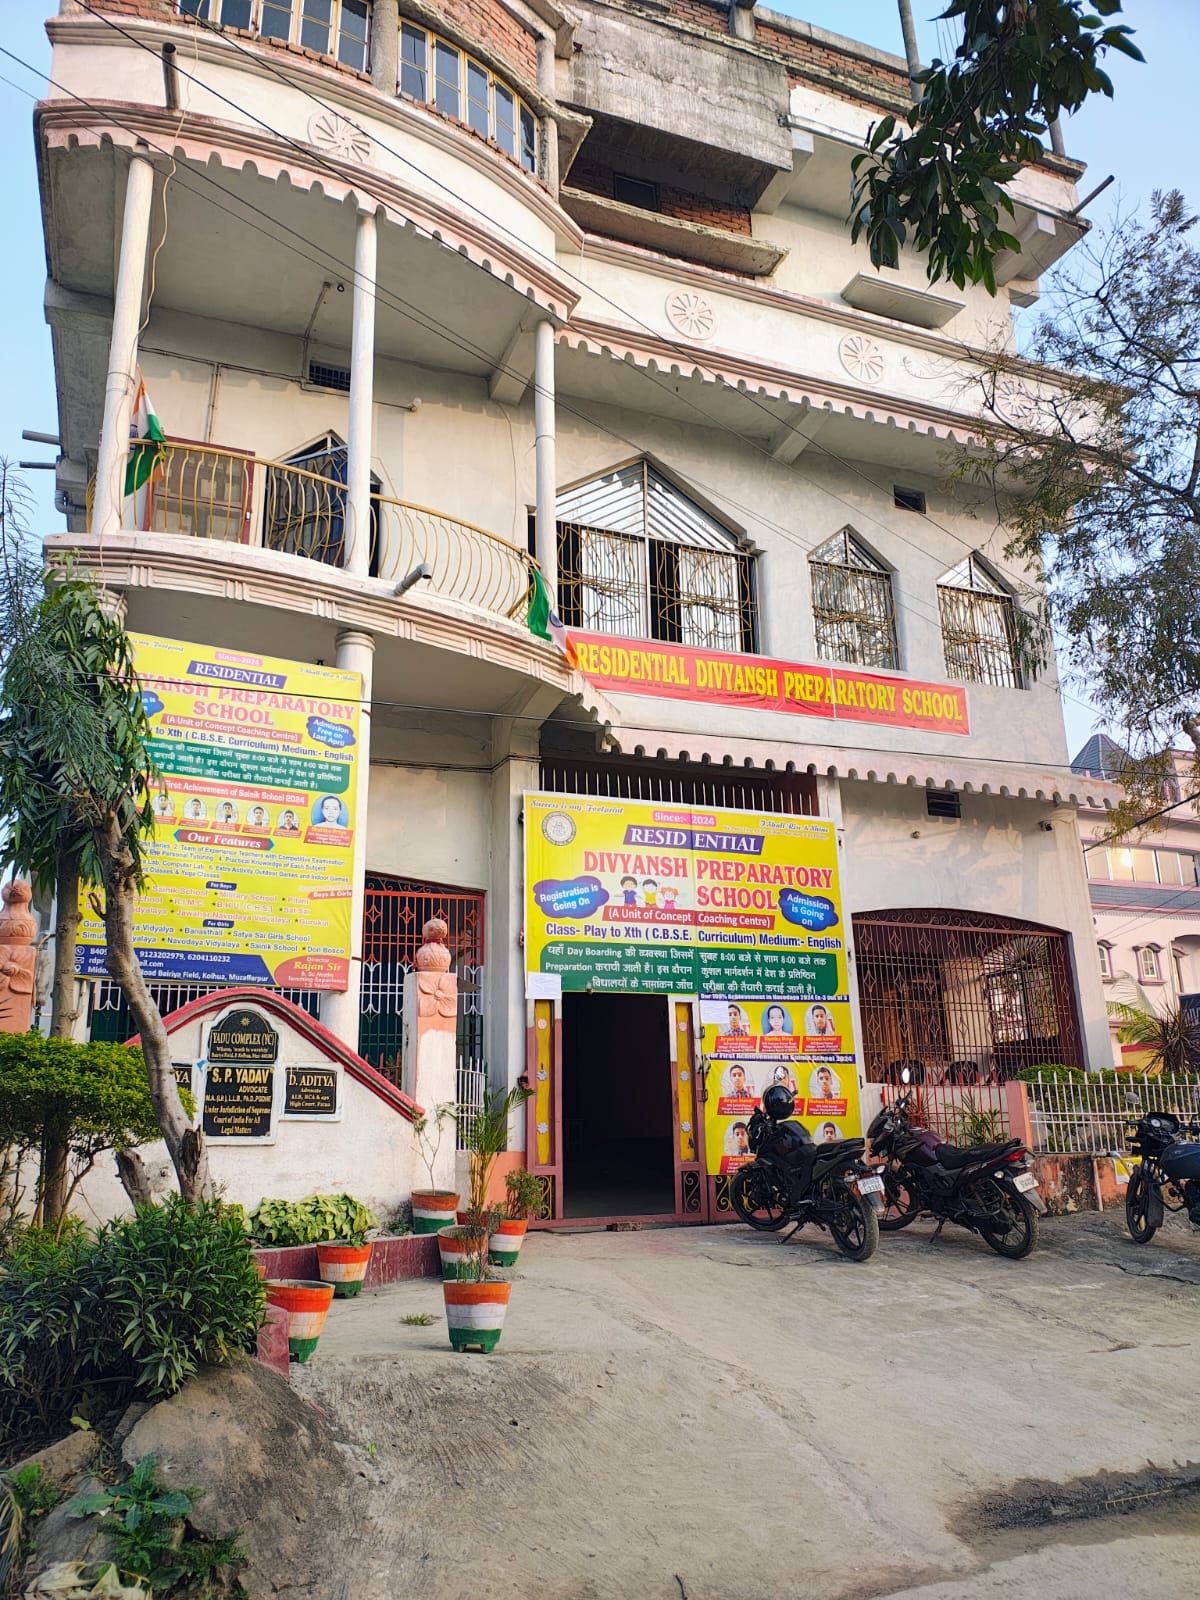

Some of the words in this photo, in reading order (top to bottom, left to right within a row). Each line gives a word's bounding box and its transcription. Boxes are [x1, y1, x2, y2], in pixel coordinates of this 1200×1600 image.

[195, 663, 280, 687] RESIDENTIAL
[576, 642, 690, 686] RESIDENTIAL
[696, 658, 778, 697] DIVYANSH
[784, 671, 896, 711] PREPARATORY
[903, 685, 963, 721] SCHOOL
[218, 684, 354, 720] PREPARATORY
[193, 700, 274, 726] SCHOOL
[178, 718, 194, 726] Unit
[205, 721, 236, 732] Concept
[237, 726, 271, 738] Coaching
[271, 731, 298, 742] Centre)
[313, 719, 350, 734] Admission
[318, 727, 332, 737] Free
[156, 726, 165, 735] to
[168, 727, 183, 738] Xth
[192, 732, 226, 744] C.B.S.E.
[229, 737, 280, 752] Curriculum)
[324, 751, 354, 762] English
[313, 732, 327, 742] Last
[184, 783, 229, 795] Achievement
[230, 788, 238, 796] of
[262, 793, 284, 802] School
[286, 795, 305, 804] 2024
[655, 812, 687, 823] Since:-
[692, 816, 715, 826] 2024
[187, 832, 210, 844] Our
[214, 833, 261, 849] Features
[584, 851, 689, 878] DIVYANSH
[696, 859, 833, 889] PREPARATORY
[540, 886, 590, 903] Registration
[591, 883, 599, 892] is
[697, 886, 778, 911] SCHOOL
[553, 900, 577, 912] Going
[579, 897, 590, 906] On
[787, 893, 830, 911] Admission
[608, 908, 620, 919] (A
[622, 909, 641, 920] Unit
[643, 910, 654, 920] of
[655, 911, 692, 923] Concept
[698, 913, 737, 926] Coaching
[739, 915, 771, 929] Centre)
[792, 905, 799, 913] is
[800, 907, 824, 920] Going
[802, 918, 813, 927] on
[286, 934, 310, 942] School
[546, 922, 580, 936] Class-
[584, 924, 607, 939] Play
[611, 926, 621, 938] to
[624, 927, 642, 939] Xth
[652, 928, 692, 941] C.B.S.E.
[698, 930, 757, 946] Curriculum)
[759, 934, 805, 947] Medium:-
[808, 936, 842, 950] English
[168, 937, 204, 947] Navodaya
[205, 938, 240, 950] Vidyalaya
[250, 942, 271, 950] Sainik
[274, 944, 298, 952] School
[323, 947, 344, 955] Bosco
[547, 944, 564, 956] यहाँ
[568, 947, 583, 958] Day
[585, 947, 622, 959] Boarding
[625, 946, 636, 957] की
[639, 949, 668, 959] व्यवस्था
[700, 952, 717, 964] सुबह
[720, 952, 736, 962] 8:00
[738, 952, 751, 963] बजे
[755, 953, 762, 964] से
[764, 955, 779, 965] शाम
[781, 956, 796, 965] 8:00
[798, 955, 811, 966] बजे
[814, 957, 827, 966] तक
[294, 961, 324, 972] Rajan
[327, 962, 343, 972] Sir
[545, 962, 592, 973] Preparation
[623, 962, 642, 974] जाती
[657, 965, 670, 975] इस
[764, 969, 777, 979] देश
[779, 967, 786, 979] के
[183, 972, 201, 981] Field,
[229, 974, 269, 983] Muzaffarpur
[631, 977, 639, 989] के
[728, 979, 739, 992] की
[740, 980, 762, 993] तैयारी
[787, 983, 805, 995] जाती
[213, 1032, 230, 1044] YADU
[231, 1032, 261, 1045] COMPLEX
[212, 1067, 222, 1083] S.
[224, 1068, 233, 1083] P.
[235, 1068, 270, 1084] YADAV
[288, 1075, 298, 1086] D.
[299, 1075, 334, 1087] ADITYA
[238, 1085, 269, 1094] ADVOCATE
[219, 1106, 246, 1114] Jurisdiction
[251, 1106, 272, 1116] Supreme
